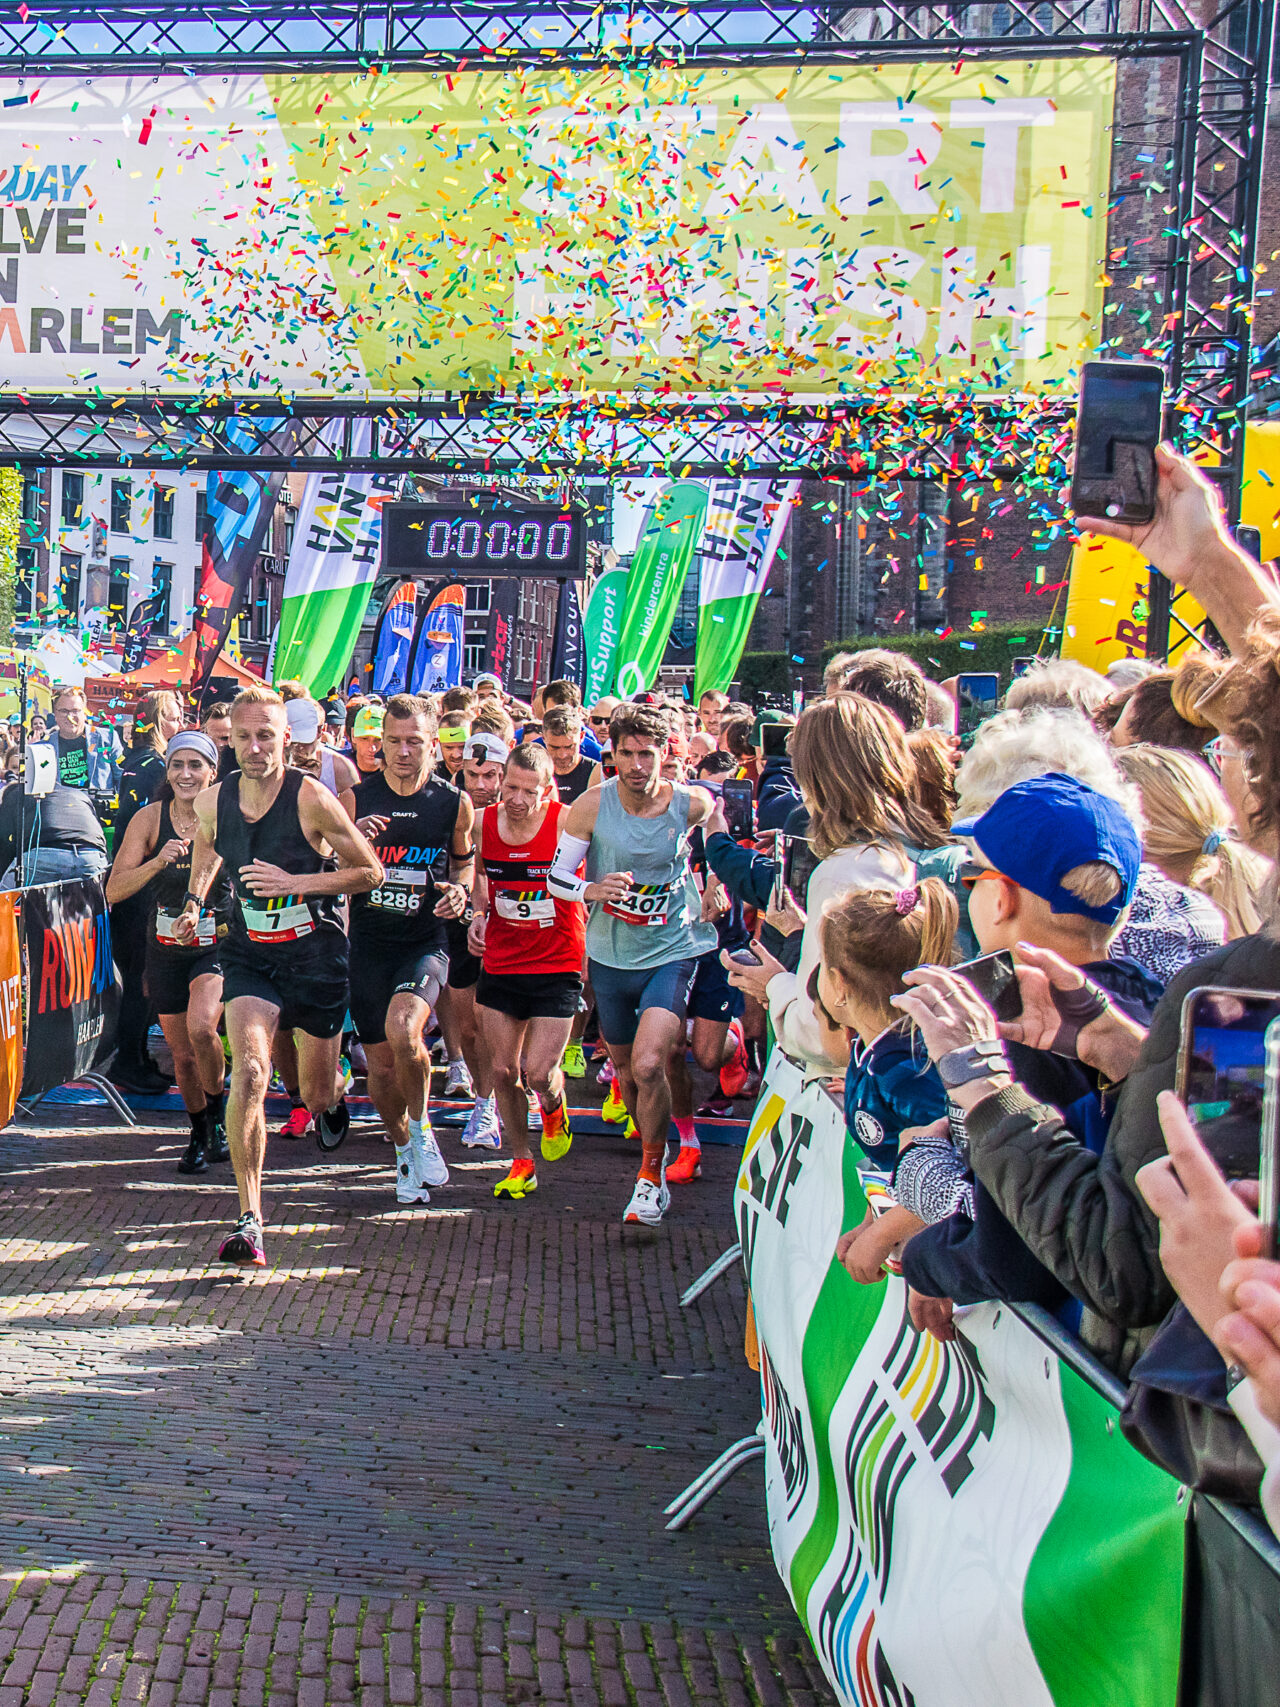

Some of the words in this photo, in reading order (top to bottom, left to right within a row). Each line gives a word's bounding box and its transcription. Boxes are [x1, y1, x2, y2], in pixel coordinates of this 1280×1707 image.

[518, 98, 1054, 218] START
[511, 246, 1053, 361] FINISH
[278, 489, 293, 504] OTEL
[327, 487, 367, 554] VAN
[724, 494, 763, 562] VAN
[264, 557, 289, 576] CARILL
[638, 552, 669, 638] kindercentra
[562, 590, 578, 683] EAVOUR
[586, 586, 617, 710] ortSupport
[375, 845, 443, 865] UN2DAY
[265, 912, 281, 930] 7
[370, 889, 420, 910] 8286
[516, 903, 531, 918] 9
[613, 894, 669, 914] 407
[37, 908, 115, 1015] RUN2DA
[76, 1013, 105, 1046] HAARLEM
[738, 1081, 814, 1229] ALVE
[845, 1379, 917, 1606] VAN
